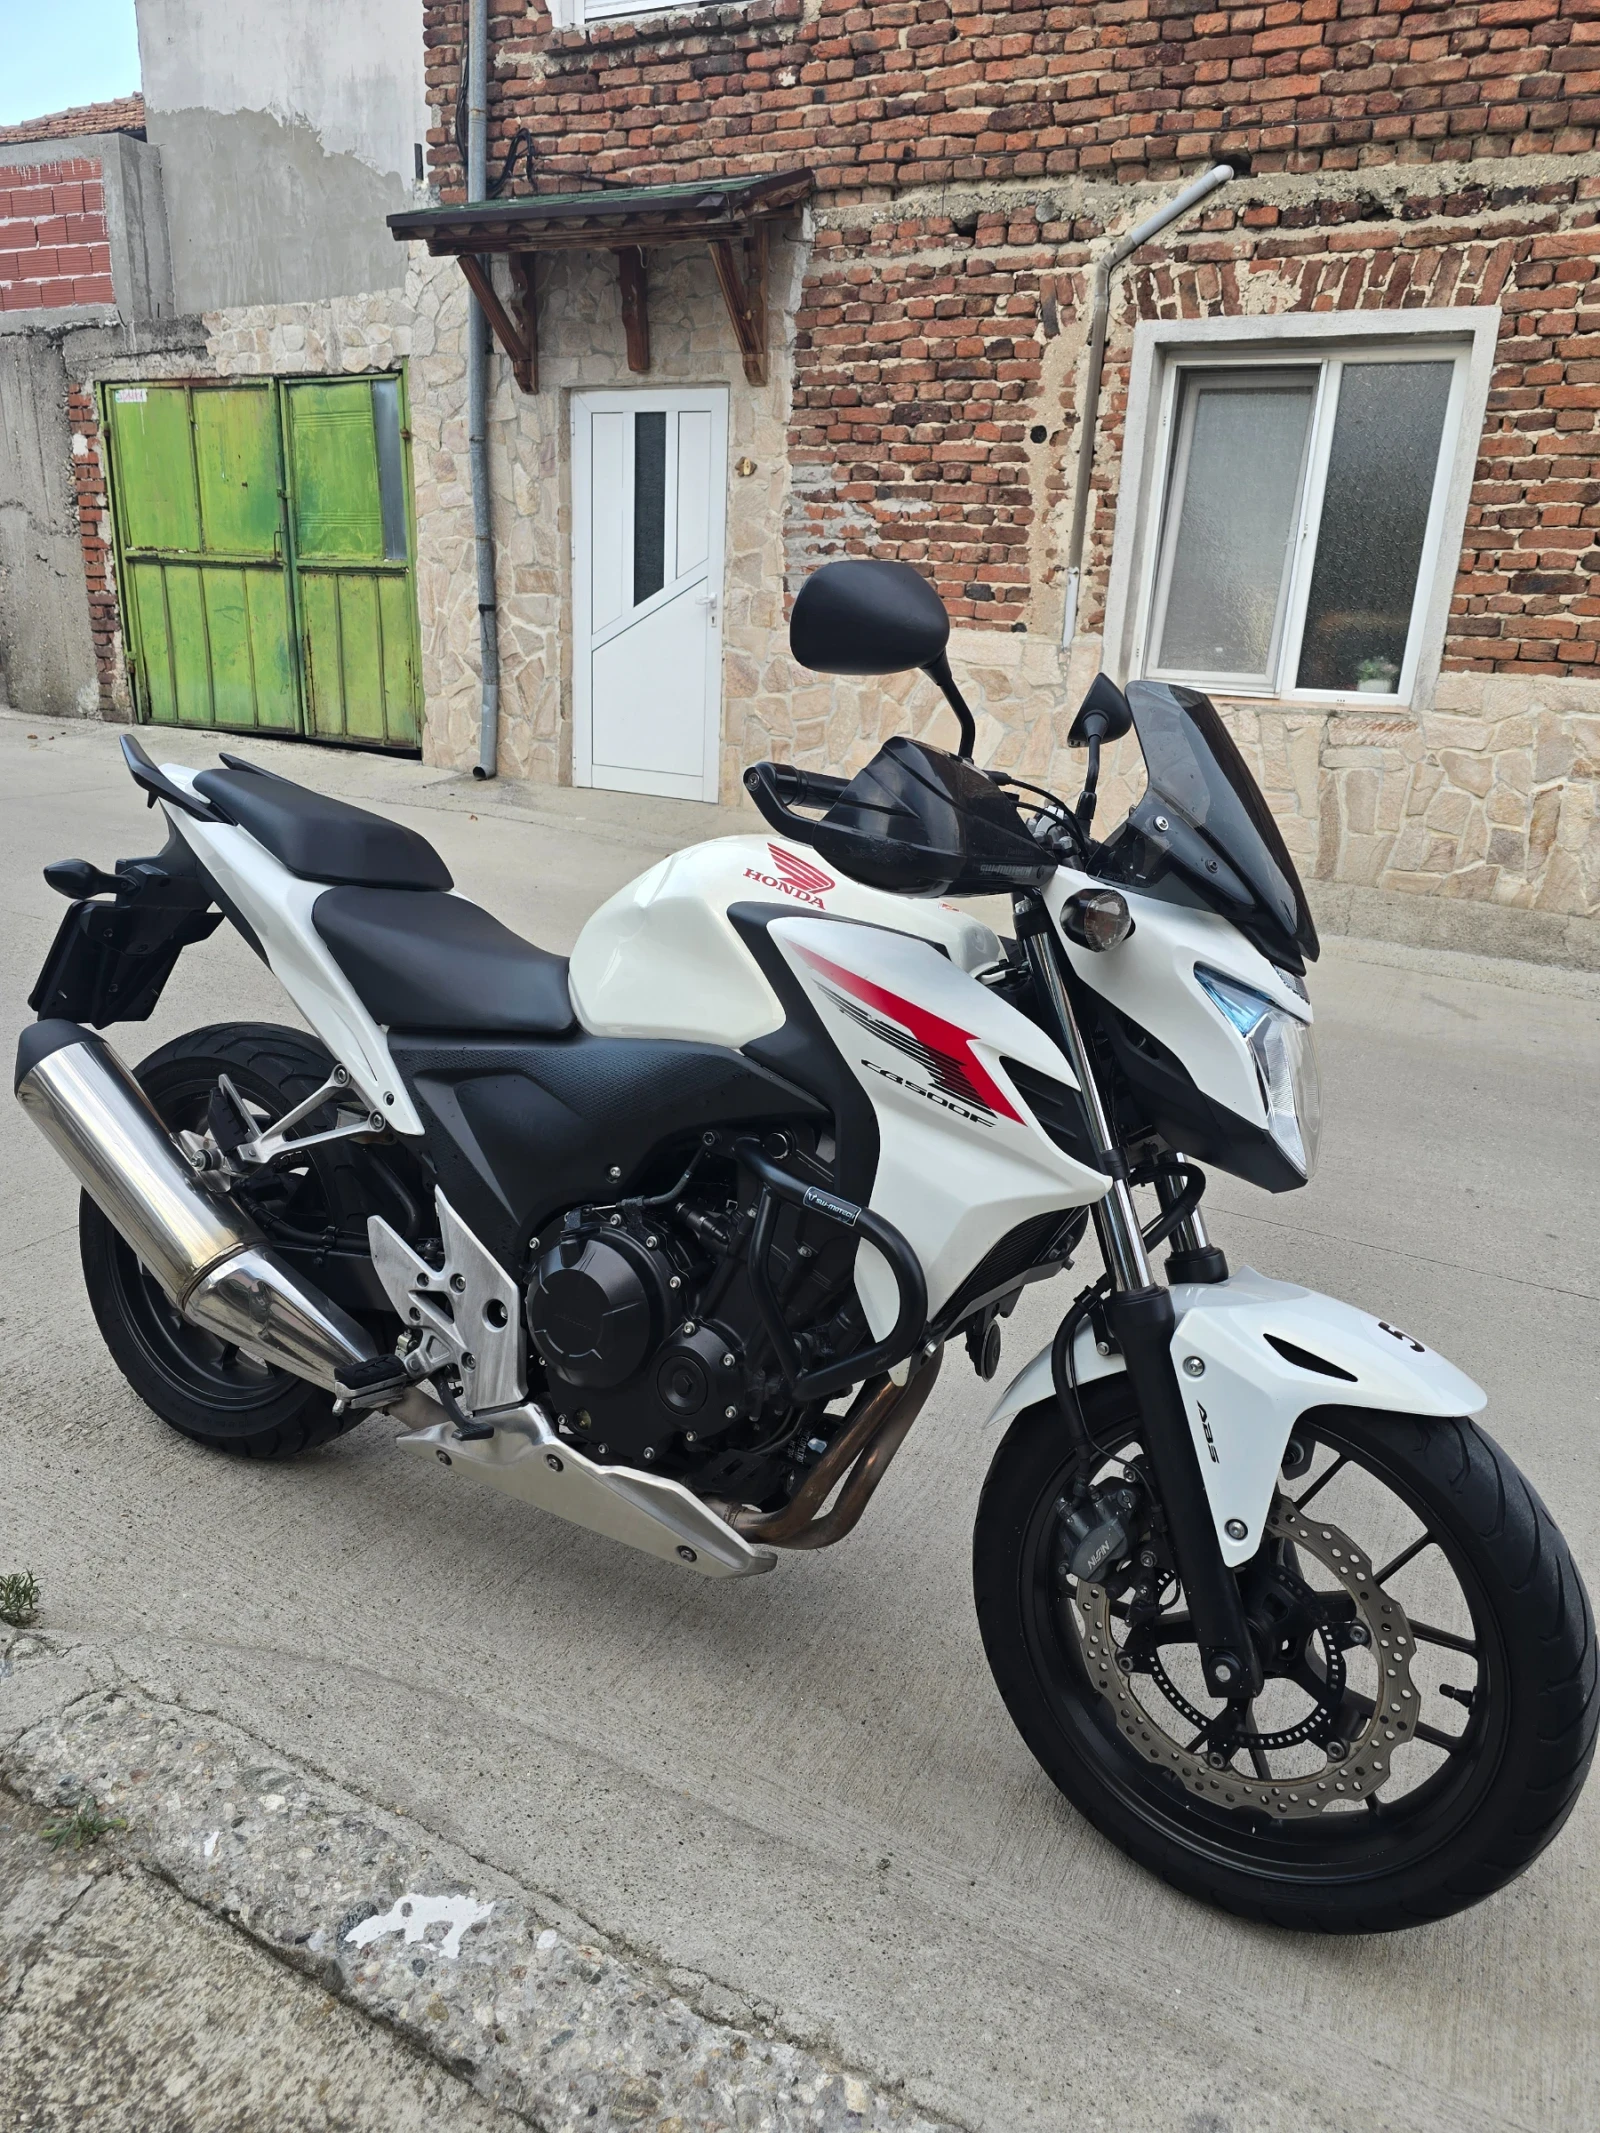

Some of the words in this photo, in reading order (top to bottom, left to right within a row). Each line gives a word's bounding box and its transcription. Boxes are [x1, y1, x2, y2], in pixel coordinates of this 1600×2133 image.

[743, 868, 826, 910] HONDA
[980, 864, 1034, 877] SW-MOTECH
[861, 1059, 996, 1128] CB500F
[815, 1198, 856, 1219] SW-MOTECH
[1196, 1400, 1220, 1464] ABS
